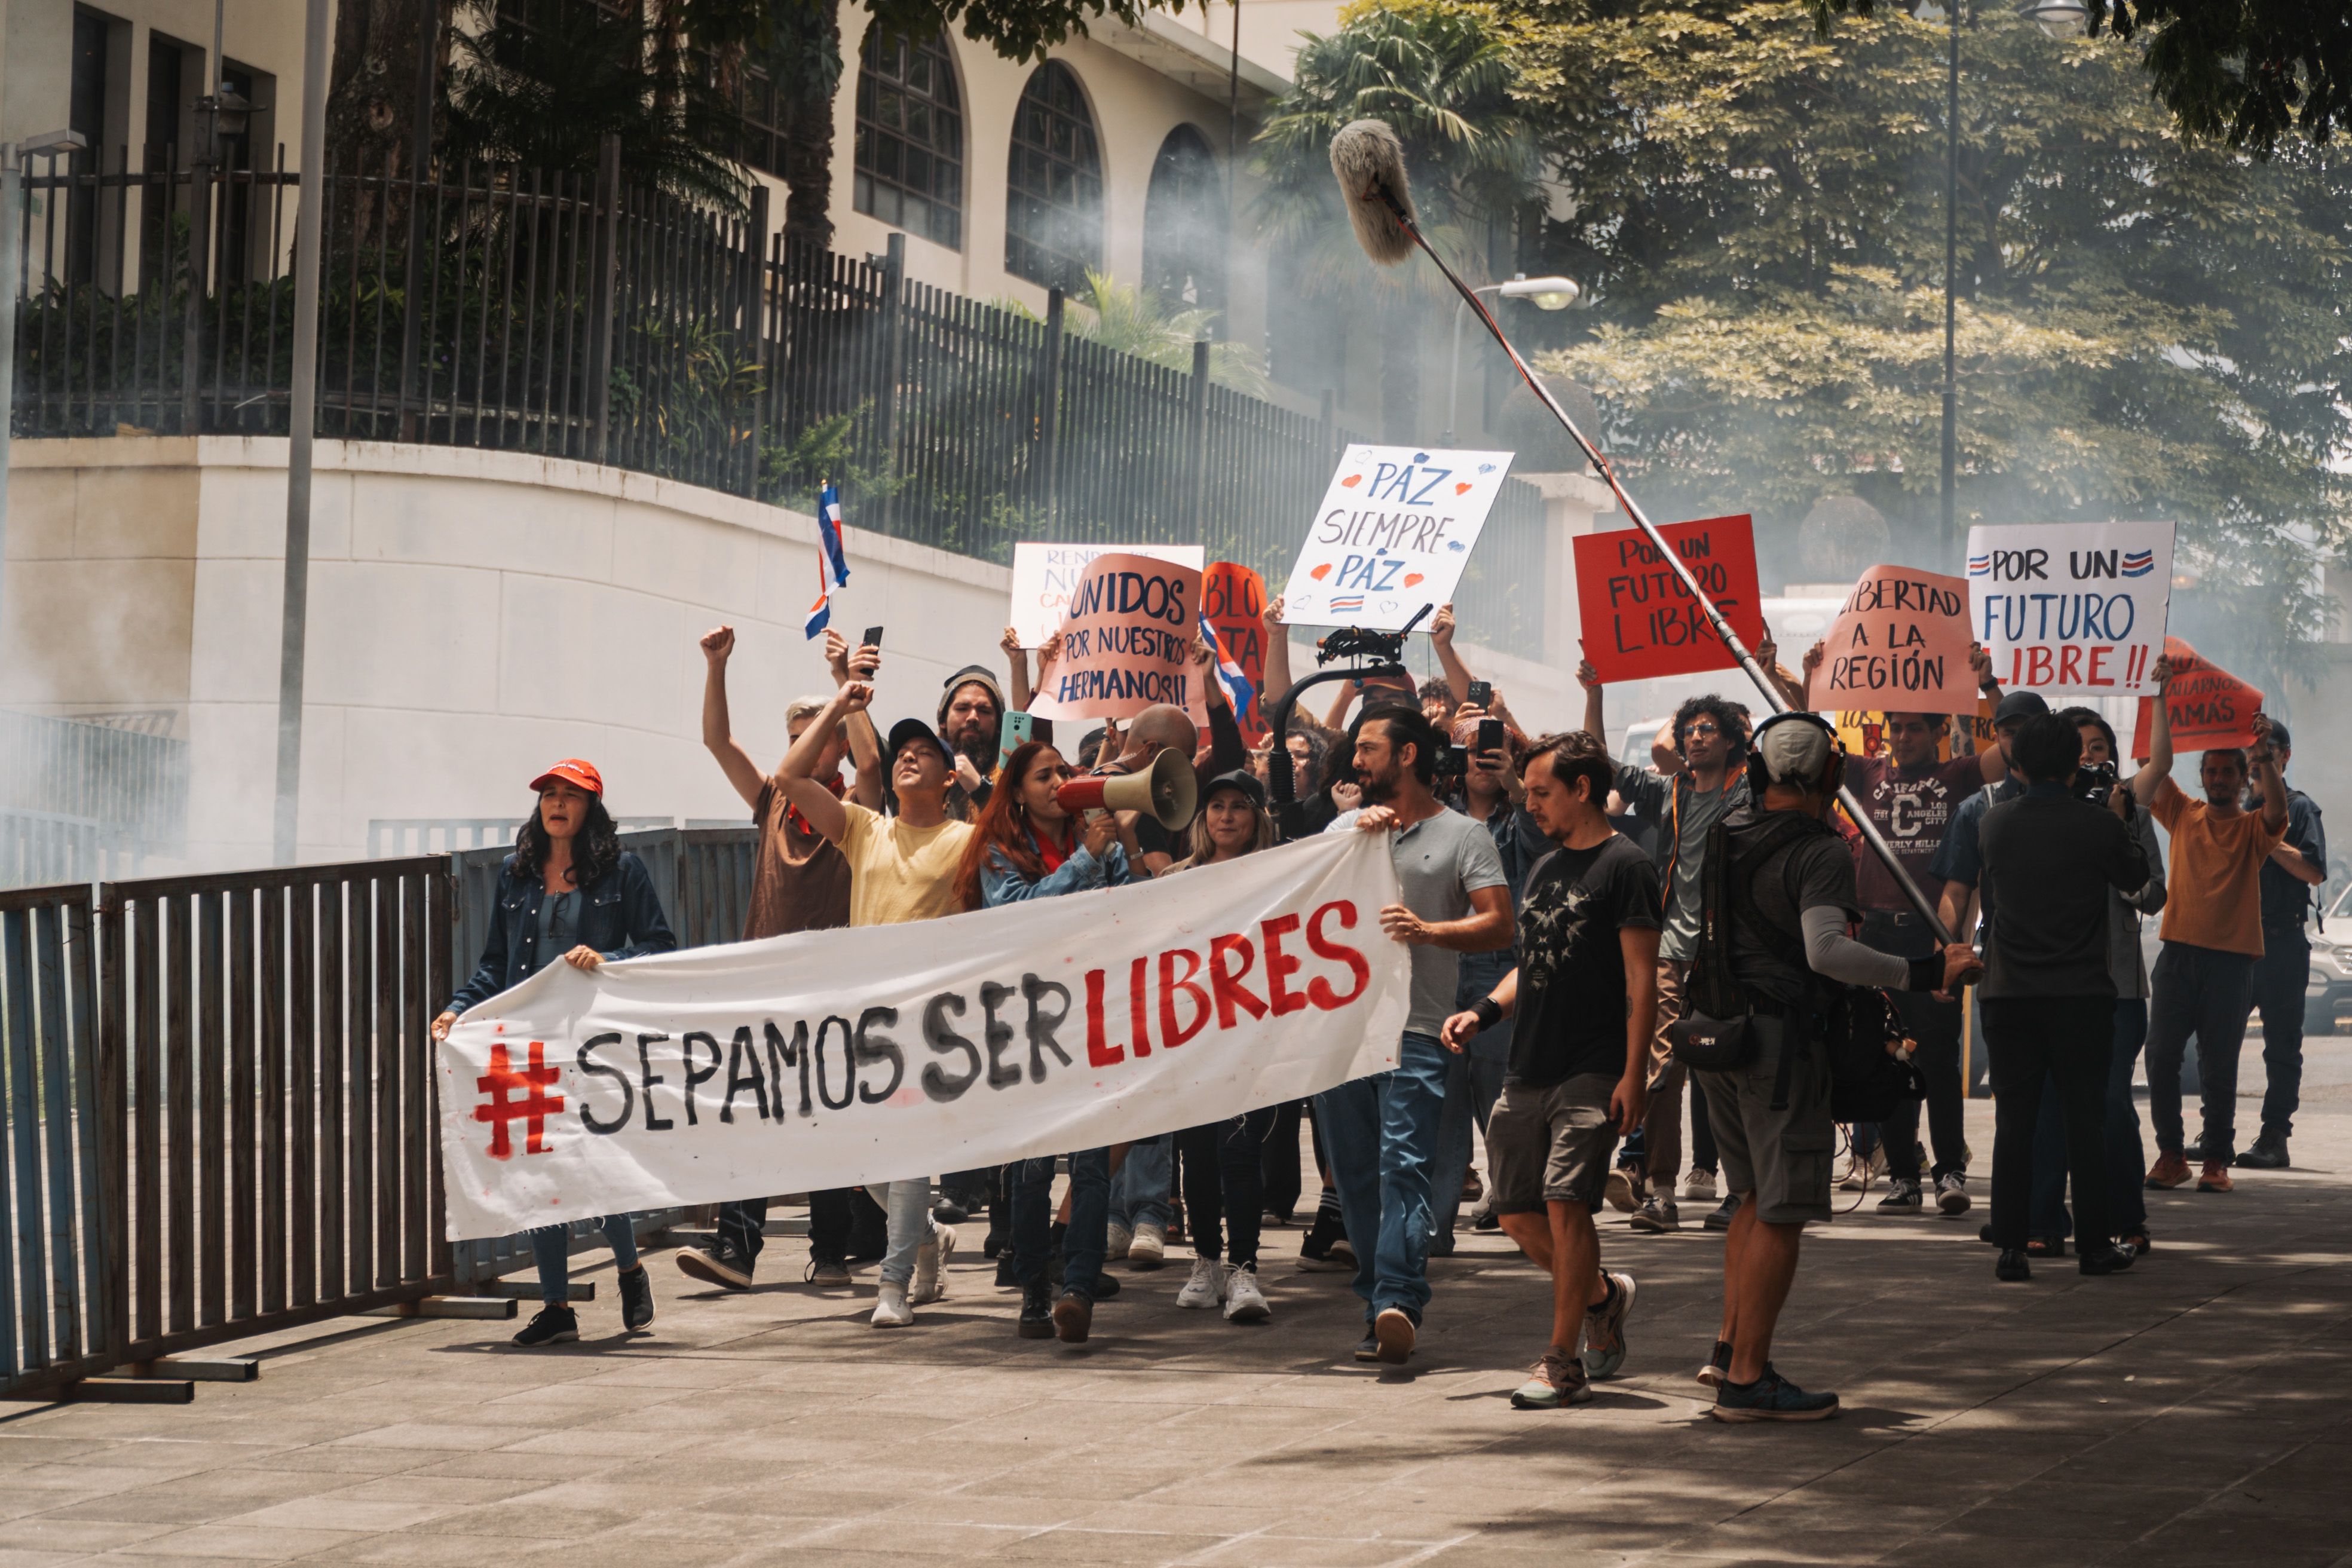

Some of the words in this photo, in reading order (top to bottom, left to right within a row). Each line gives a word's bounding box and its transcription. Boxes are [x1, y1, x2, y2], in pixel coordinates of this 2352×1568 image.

[1318, 509, 1454, 554] SIEMPRE
[1679, 532, 1710, 559] UN
[1608, 562, 1727, 608] FUTURO
[1993, 549, 2048, 581] POR
[2070, 549, 2118, 580] UN
[1070, 572, 1185, 626] UNIDOS
[1984, 593, 2134, 641] FUTURO
[1065, 629, 1090, 663] POR
[1098, 626, 1186, 666] NUESTROS
[1852, 623, 1869, 650] A
[1888, 623, 1926, 649] LA
[1830, 649, 1943, 691] REGIÓN
[2169, 694, 2235, 728] AMÁS
